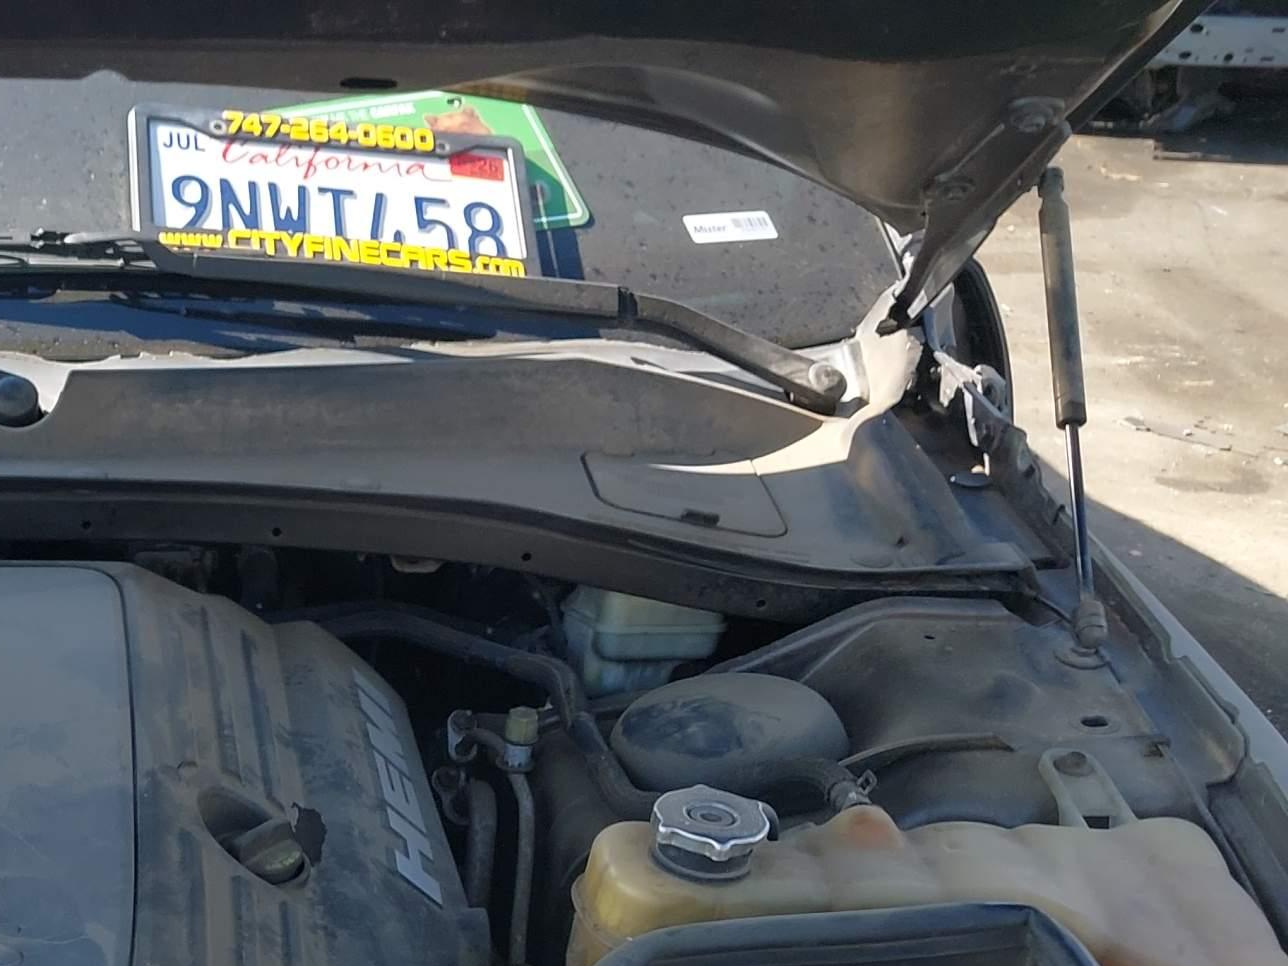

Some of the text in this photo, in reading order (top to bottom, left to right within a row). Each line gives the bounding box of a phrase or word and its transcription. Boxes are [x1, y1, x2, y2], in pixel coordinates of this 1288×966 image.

[164, 134, 206, 152] JUL
[222, 111, 434, 152] 747-264-0600
[220, 139, 452, 182] California
[159, 230, 525, 277] www.CITYFINECARS.com
[351, 667, 444, 908] HEMI
